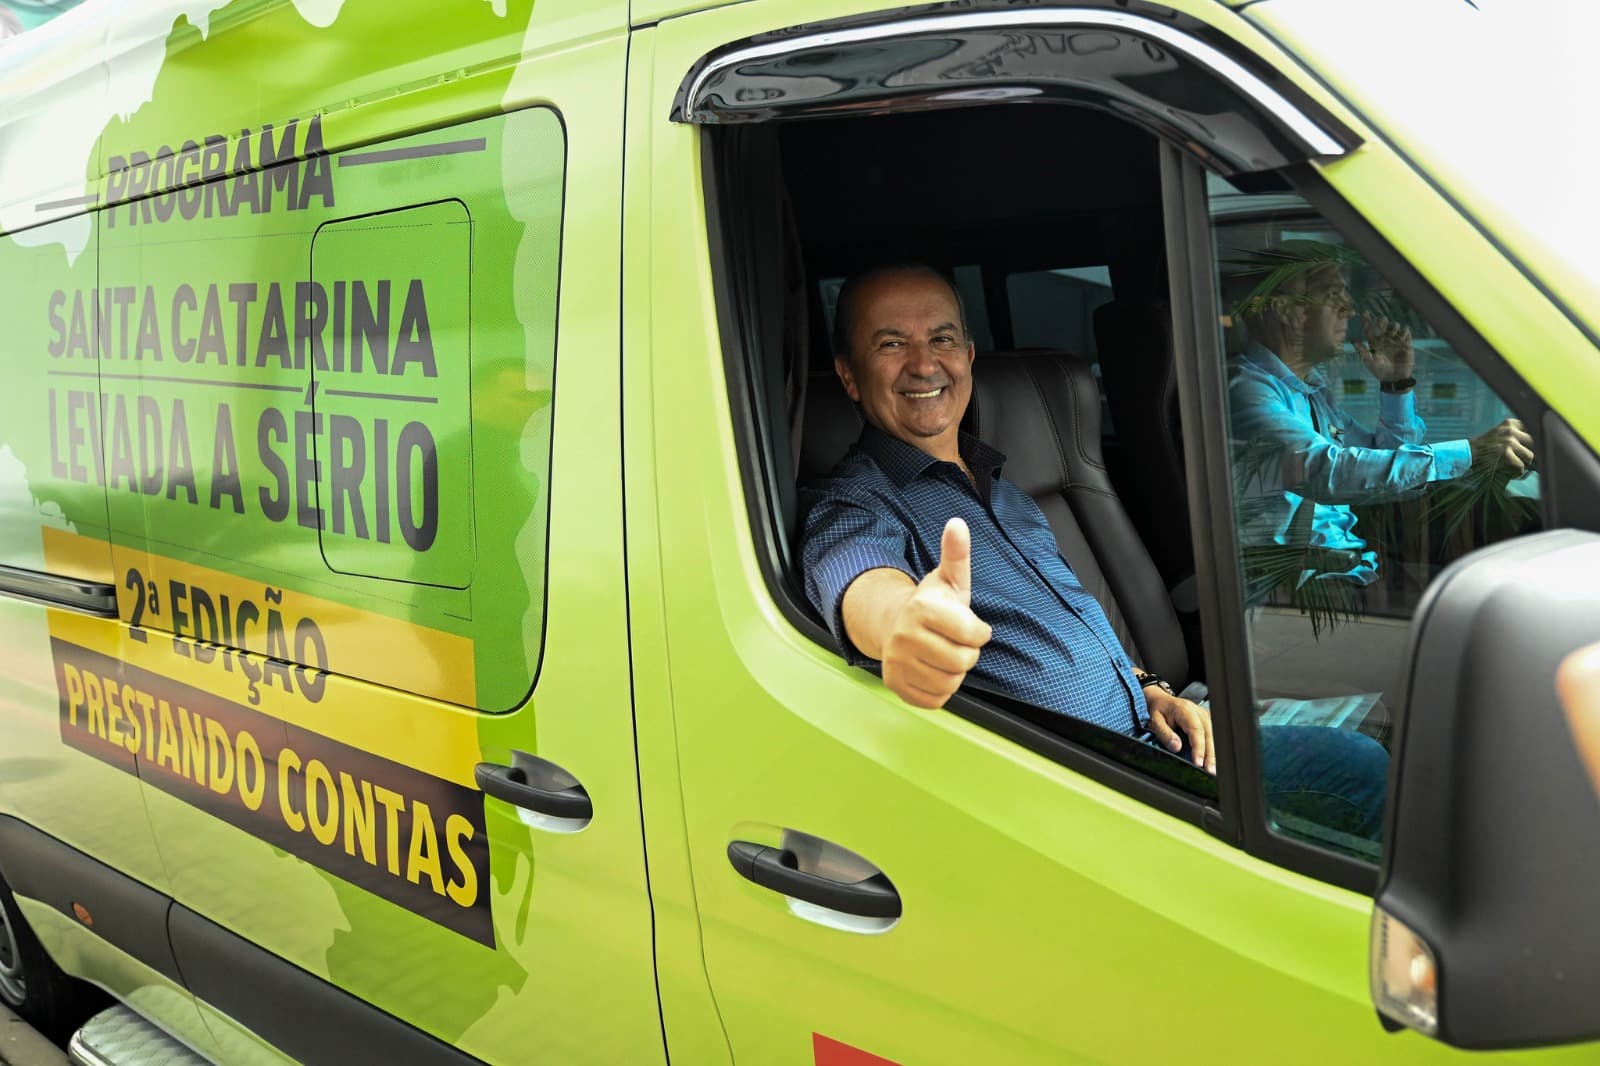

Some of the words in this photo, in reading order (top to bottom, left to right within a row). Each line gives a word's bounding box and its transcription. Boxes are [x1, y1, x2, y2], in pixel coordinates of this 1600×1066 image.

[106, 115, 335, 229] PROGRAMA
[48, 288, 163, 361] SANTA
[172, 279, 438, 378] CATARINA
[49, 388, 198, 504] LEVADA
[210, 402, 245, 514] A
[258, 381, 438, 551] SÉRIO
[169, 580, 328, 704] EDIÇÃO
[63, 662, 265, 810] PRESTANDO
[278, 748, 478, 908] CONTAS
